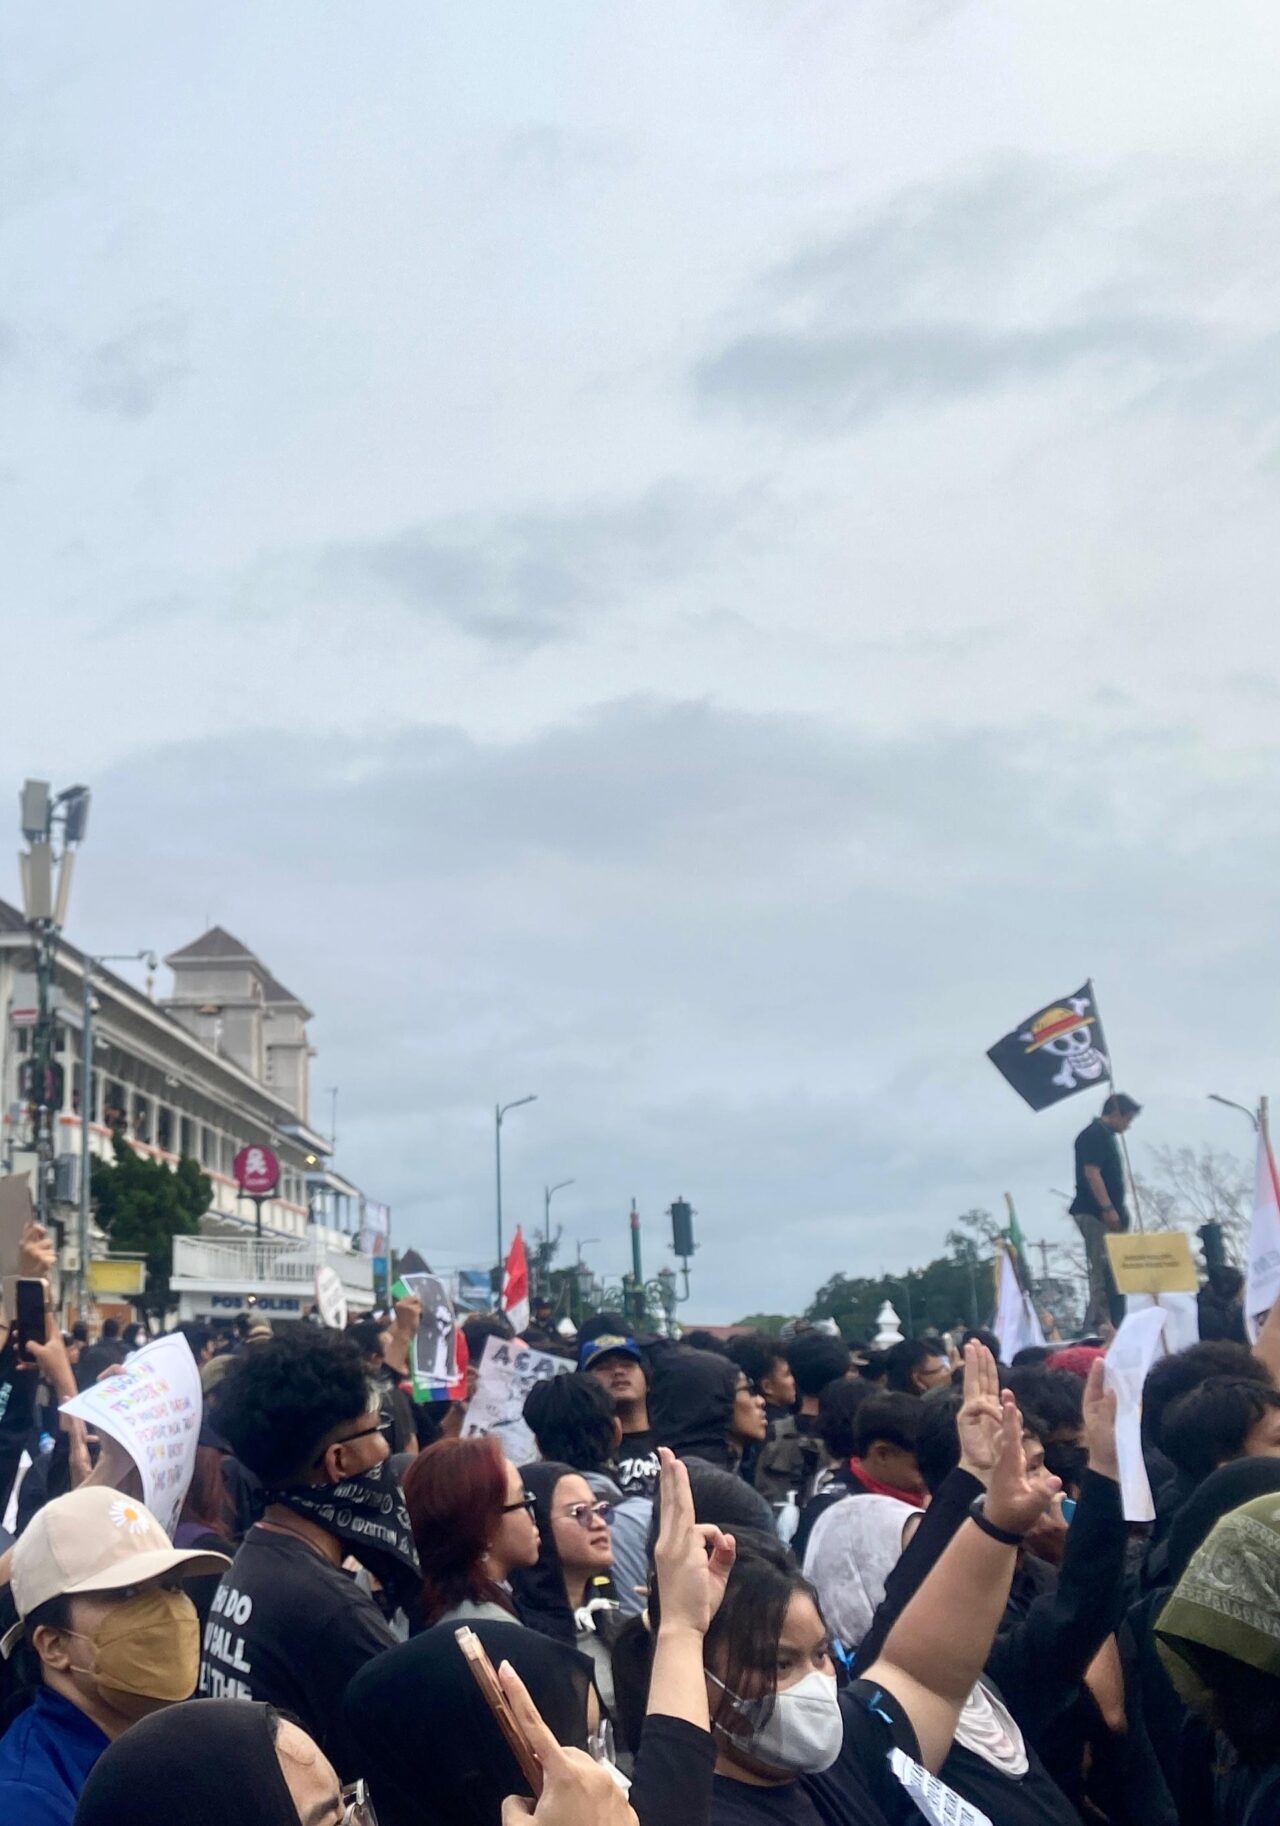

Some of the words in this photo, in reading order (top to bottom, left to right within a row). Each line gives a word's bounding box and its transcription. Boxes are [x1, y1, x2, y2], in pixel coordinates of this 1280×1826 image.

[211, 1295, 242, 1308] POS
[248, 1297, 299, 1311] OLISI
[491, 1344, 570, 1381] ACA
[223, 1588, 253, 1626] DO
[211, 1667, 252, 1701] THE
